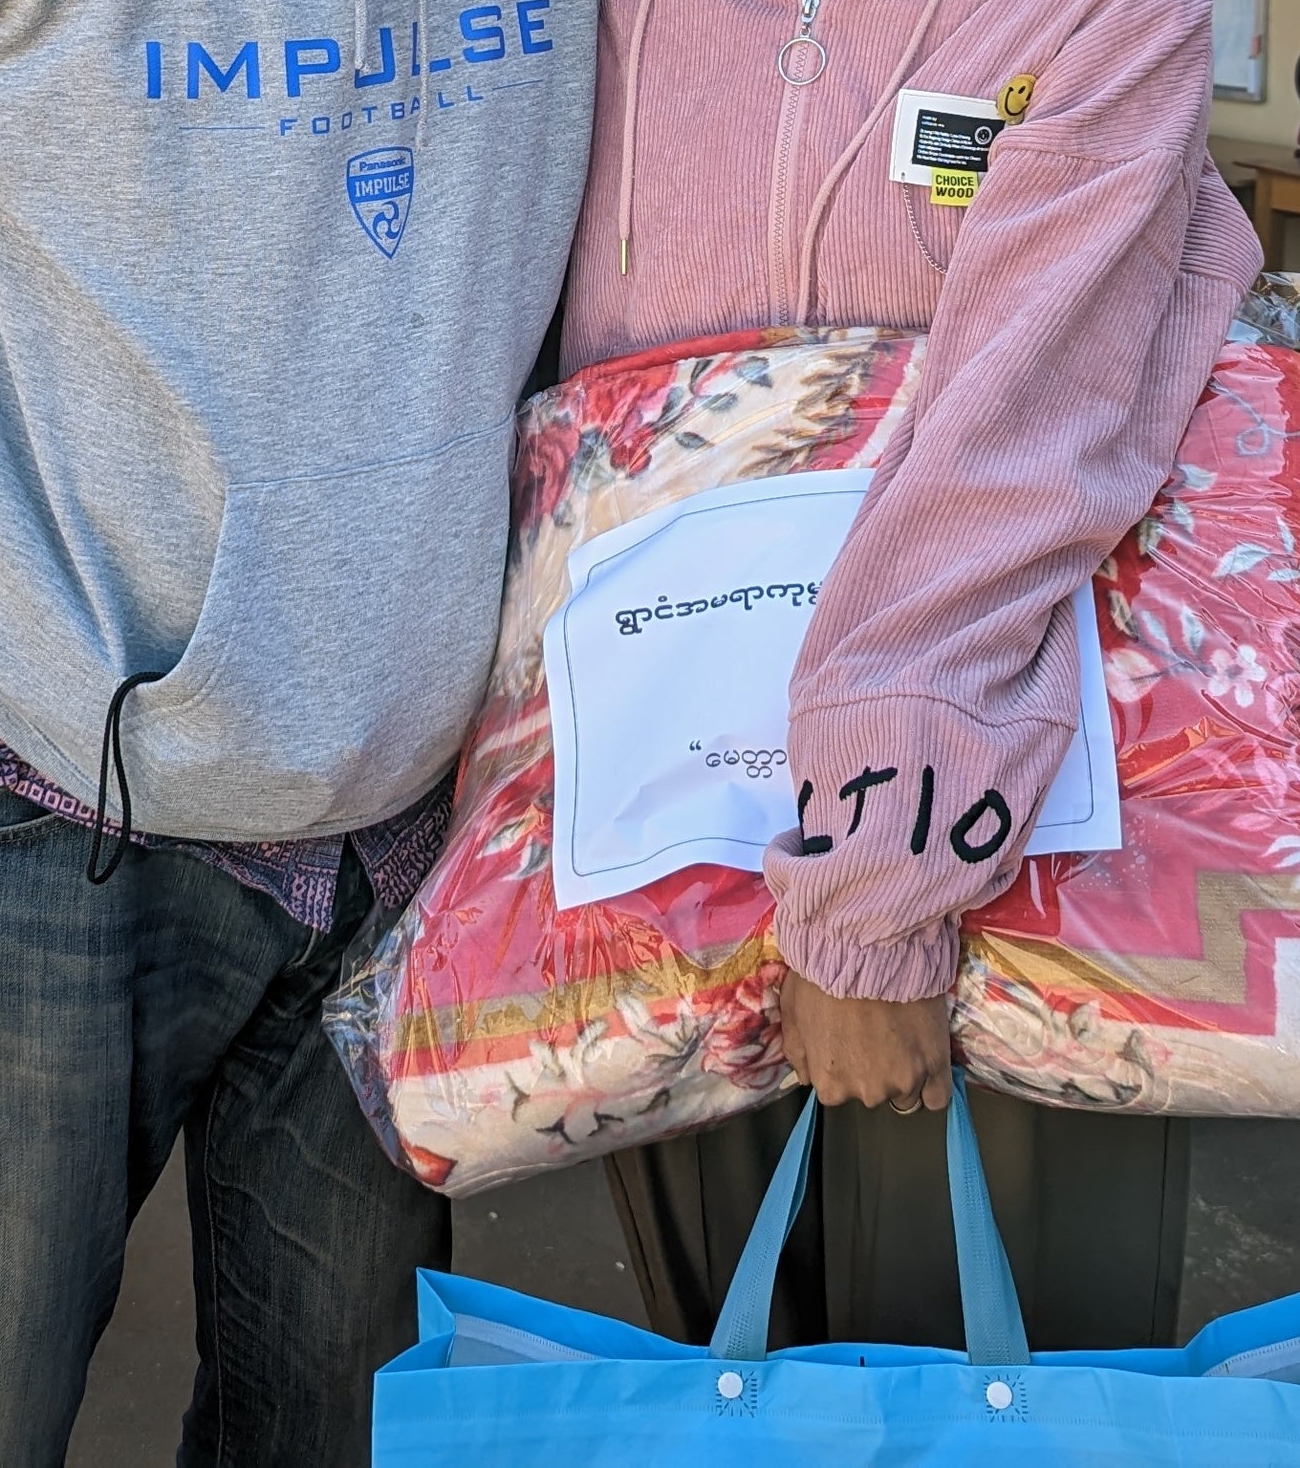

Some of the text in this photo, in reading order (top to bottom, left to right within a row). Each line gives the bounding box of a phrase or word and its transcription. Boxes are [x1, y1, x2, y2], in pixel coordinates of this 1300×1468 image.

[280, 85, 484, 136] FOOTBALL
[354, 172, 410, 198] IMPULSE
[935, 174, 975, 187] CHOICE
[935, 186, 975, 198] WOOD
